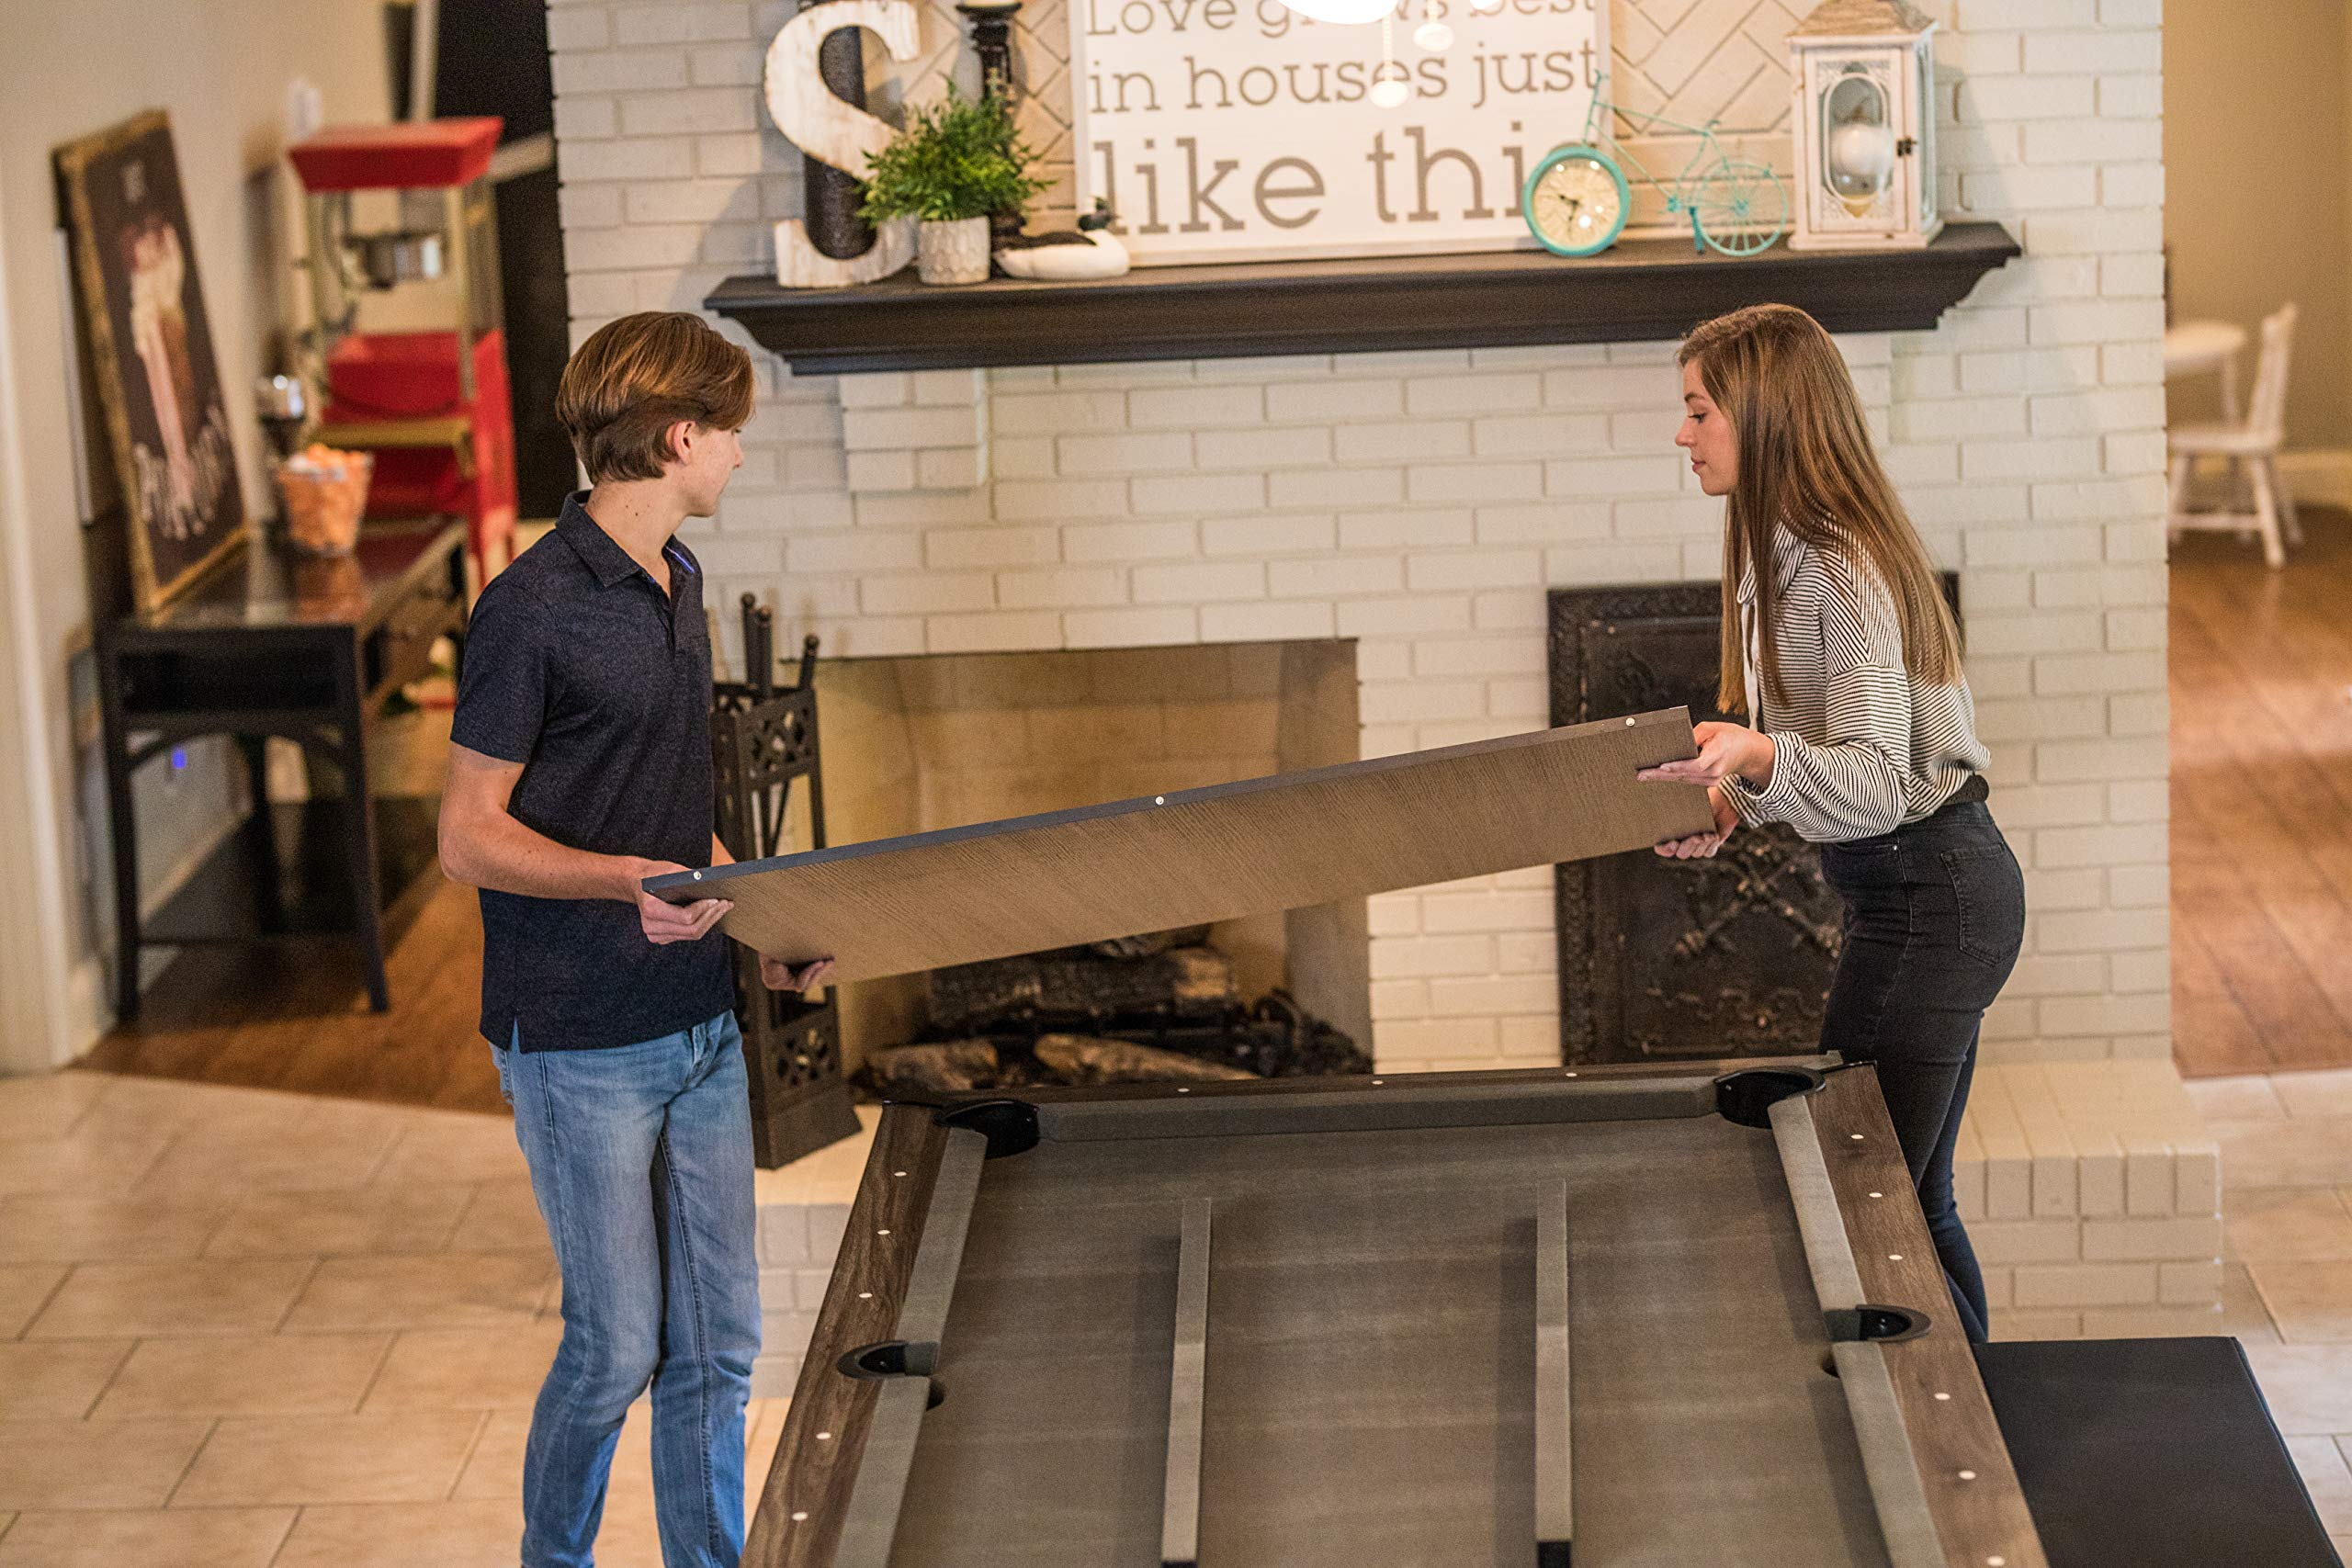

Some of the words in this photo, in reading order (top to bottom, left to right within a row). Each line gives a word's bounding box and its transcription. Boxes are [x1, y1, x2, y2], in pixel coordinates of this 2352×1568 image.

[1087, 0, 1238, 35] Love
[1088, 60, 1161, 114] in
[1473, 39, 1596, 108] just
[765, 0, 920, 288] S
[1093, 137, 1325, 236] like
[1365, 120, 1599, 222] thi
